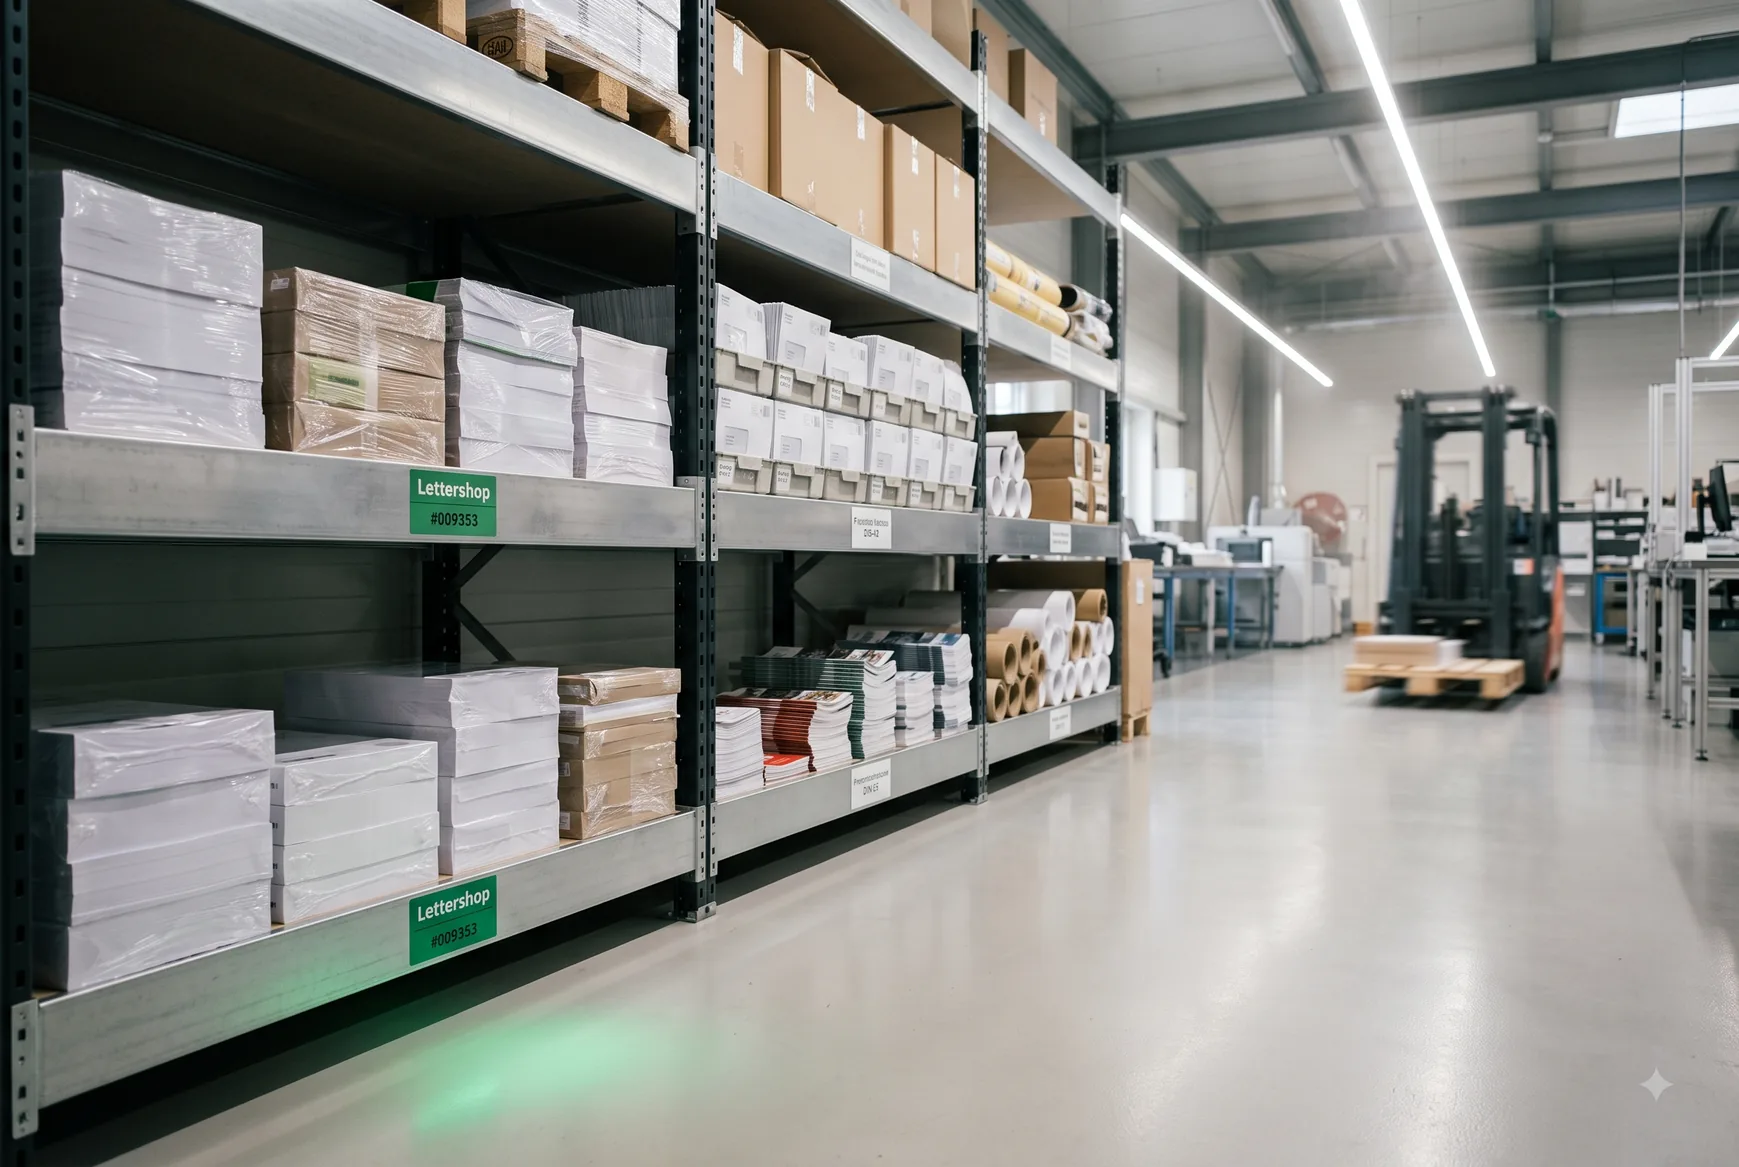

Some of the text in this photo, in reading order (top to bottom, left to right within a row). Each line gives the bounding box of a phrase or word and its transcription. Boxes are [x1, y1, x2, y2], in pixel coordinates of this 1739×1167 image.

[417, 478, 490, 503] Lettershop
[430, 511, 478, 527] #009353
[417, 888, 490, 922] Lettershop
[431, 922, 477, 948] #009353
